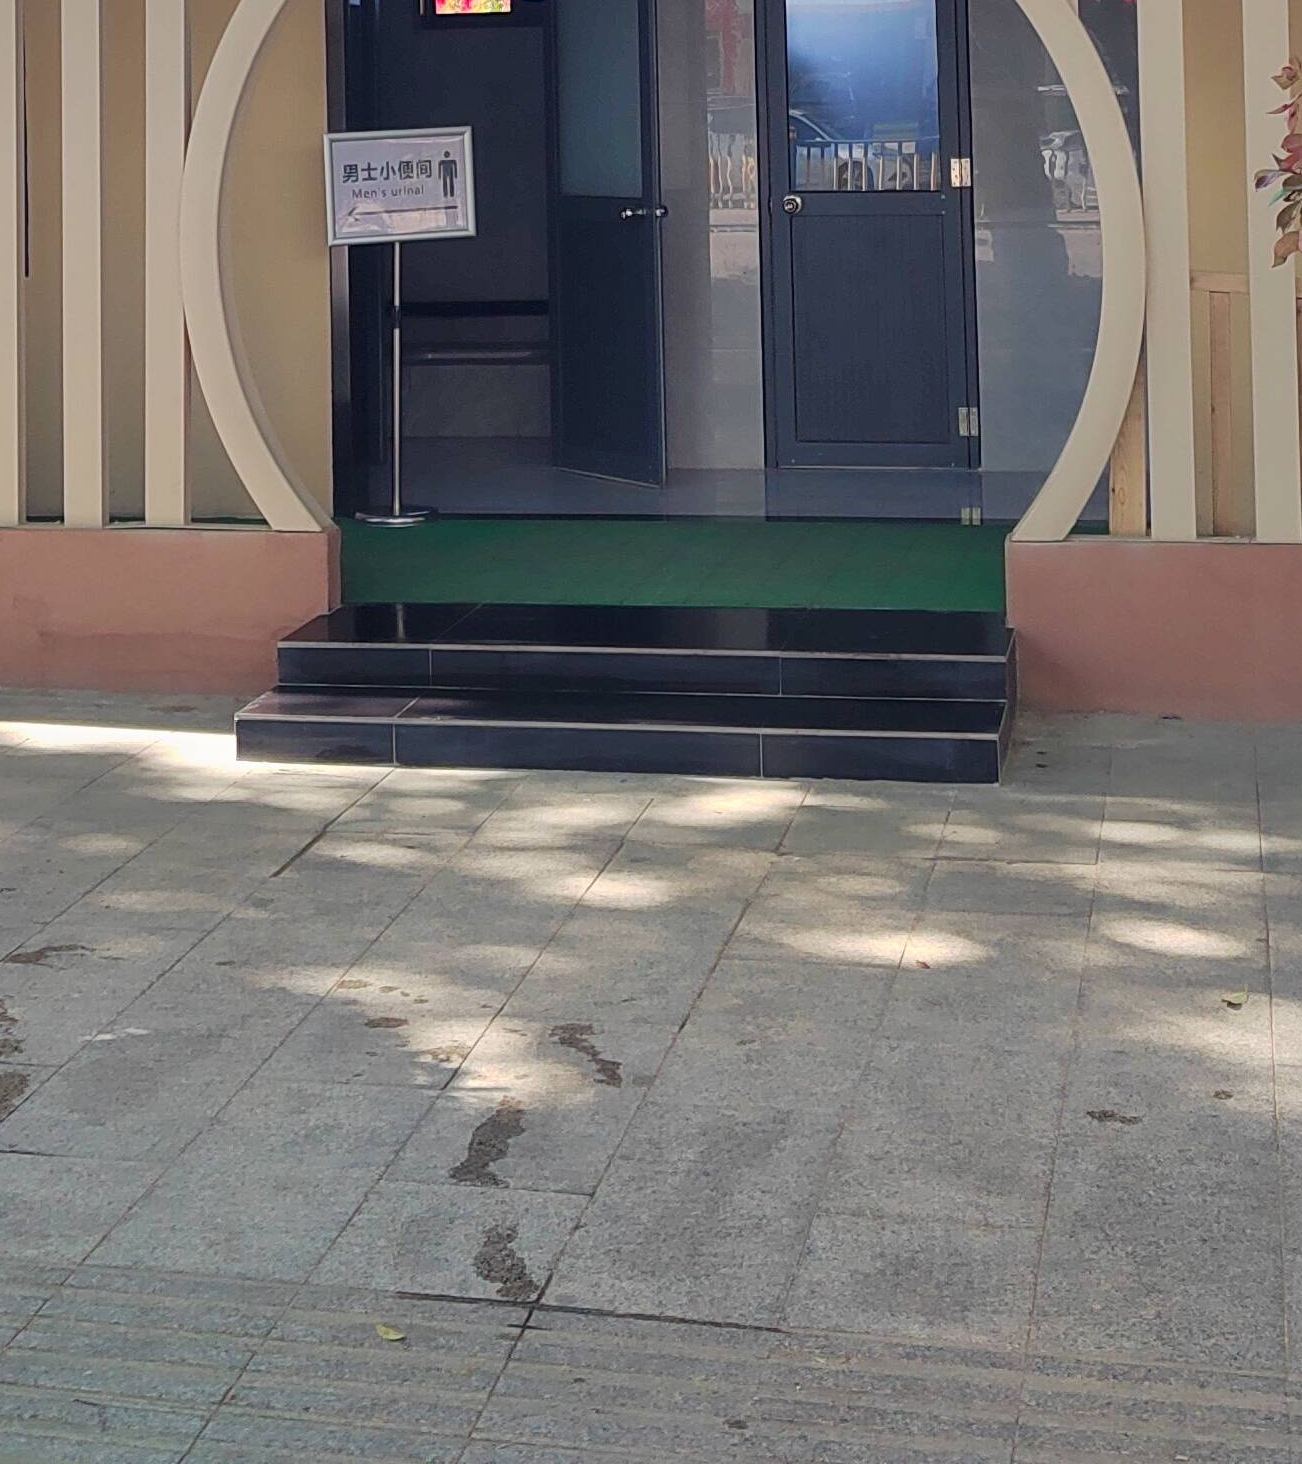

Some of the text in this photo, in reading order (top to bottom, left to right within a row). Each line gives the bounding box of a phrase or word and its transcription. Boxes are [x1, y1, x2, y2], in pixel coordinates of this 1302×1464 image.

[342, 159, 432, 184] 男士小便间
[351, 185, 424, 199] Men's urinal
